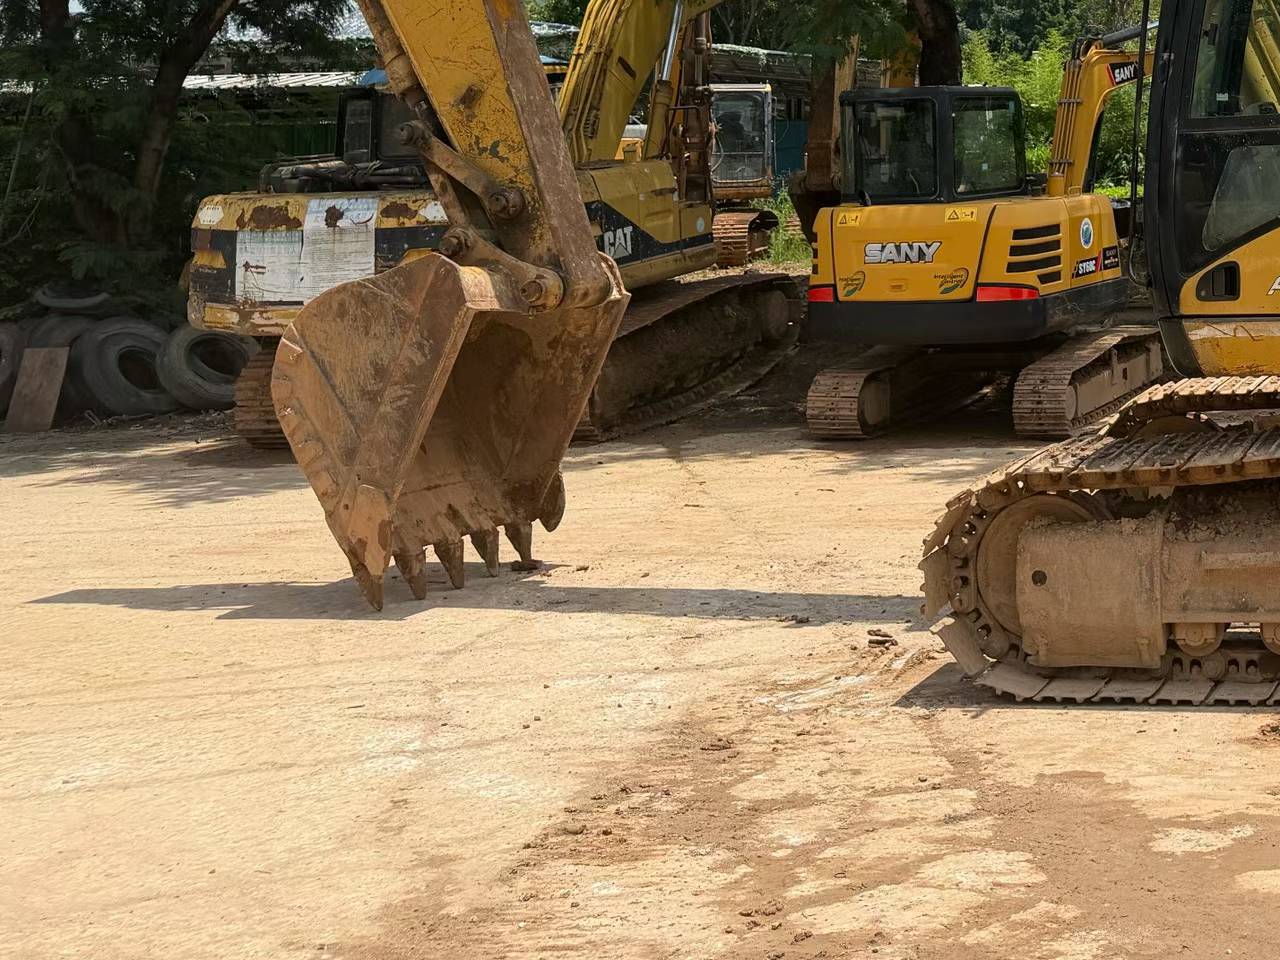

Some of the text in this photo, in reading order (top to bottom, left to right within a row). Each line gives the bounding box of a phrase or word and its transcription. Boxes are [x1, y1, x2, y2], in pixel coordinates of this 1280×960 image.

[1115, 64, 1134, 82] SANY
[604, 226, 633, 258] CAT
[864, 241, 942, 264] SANY
